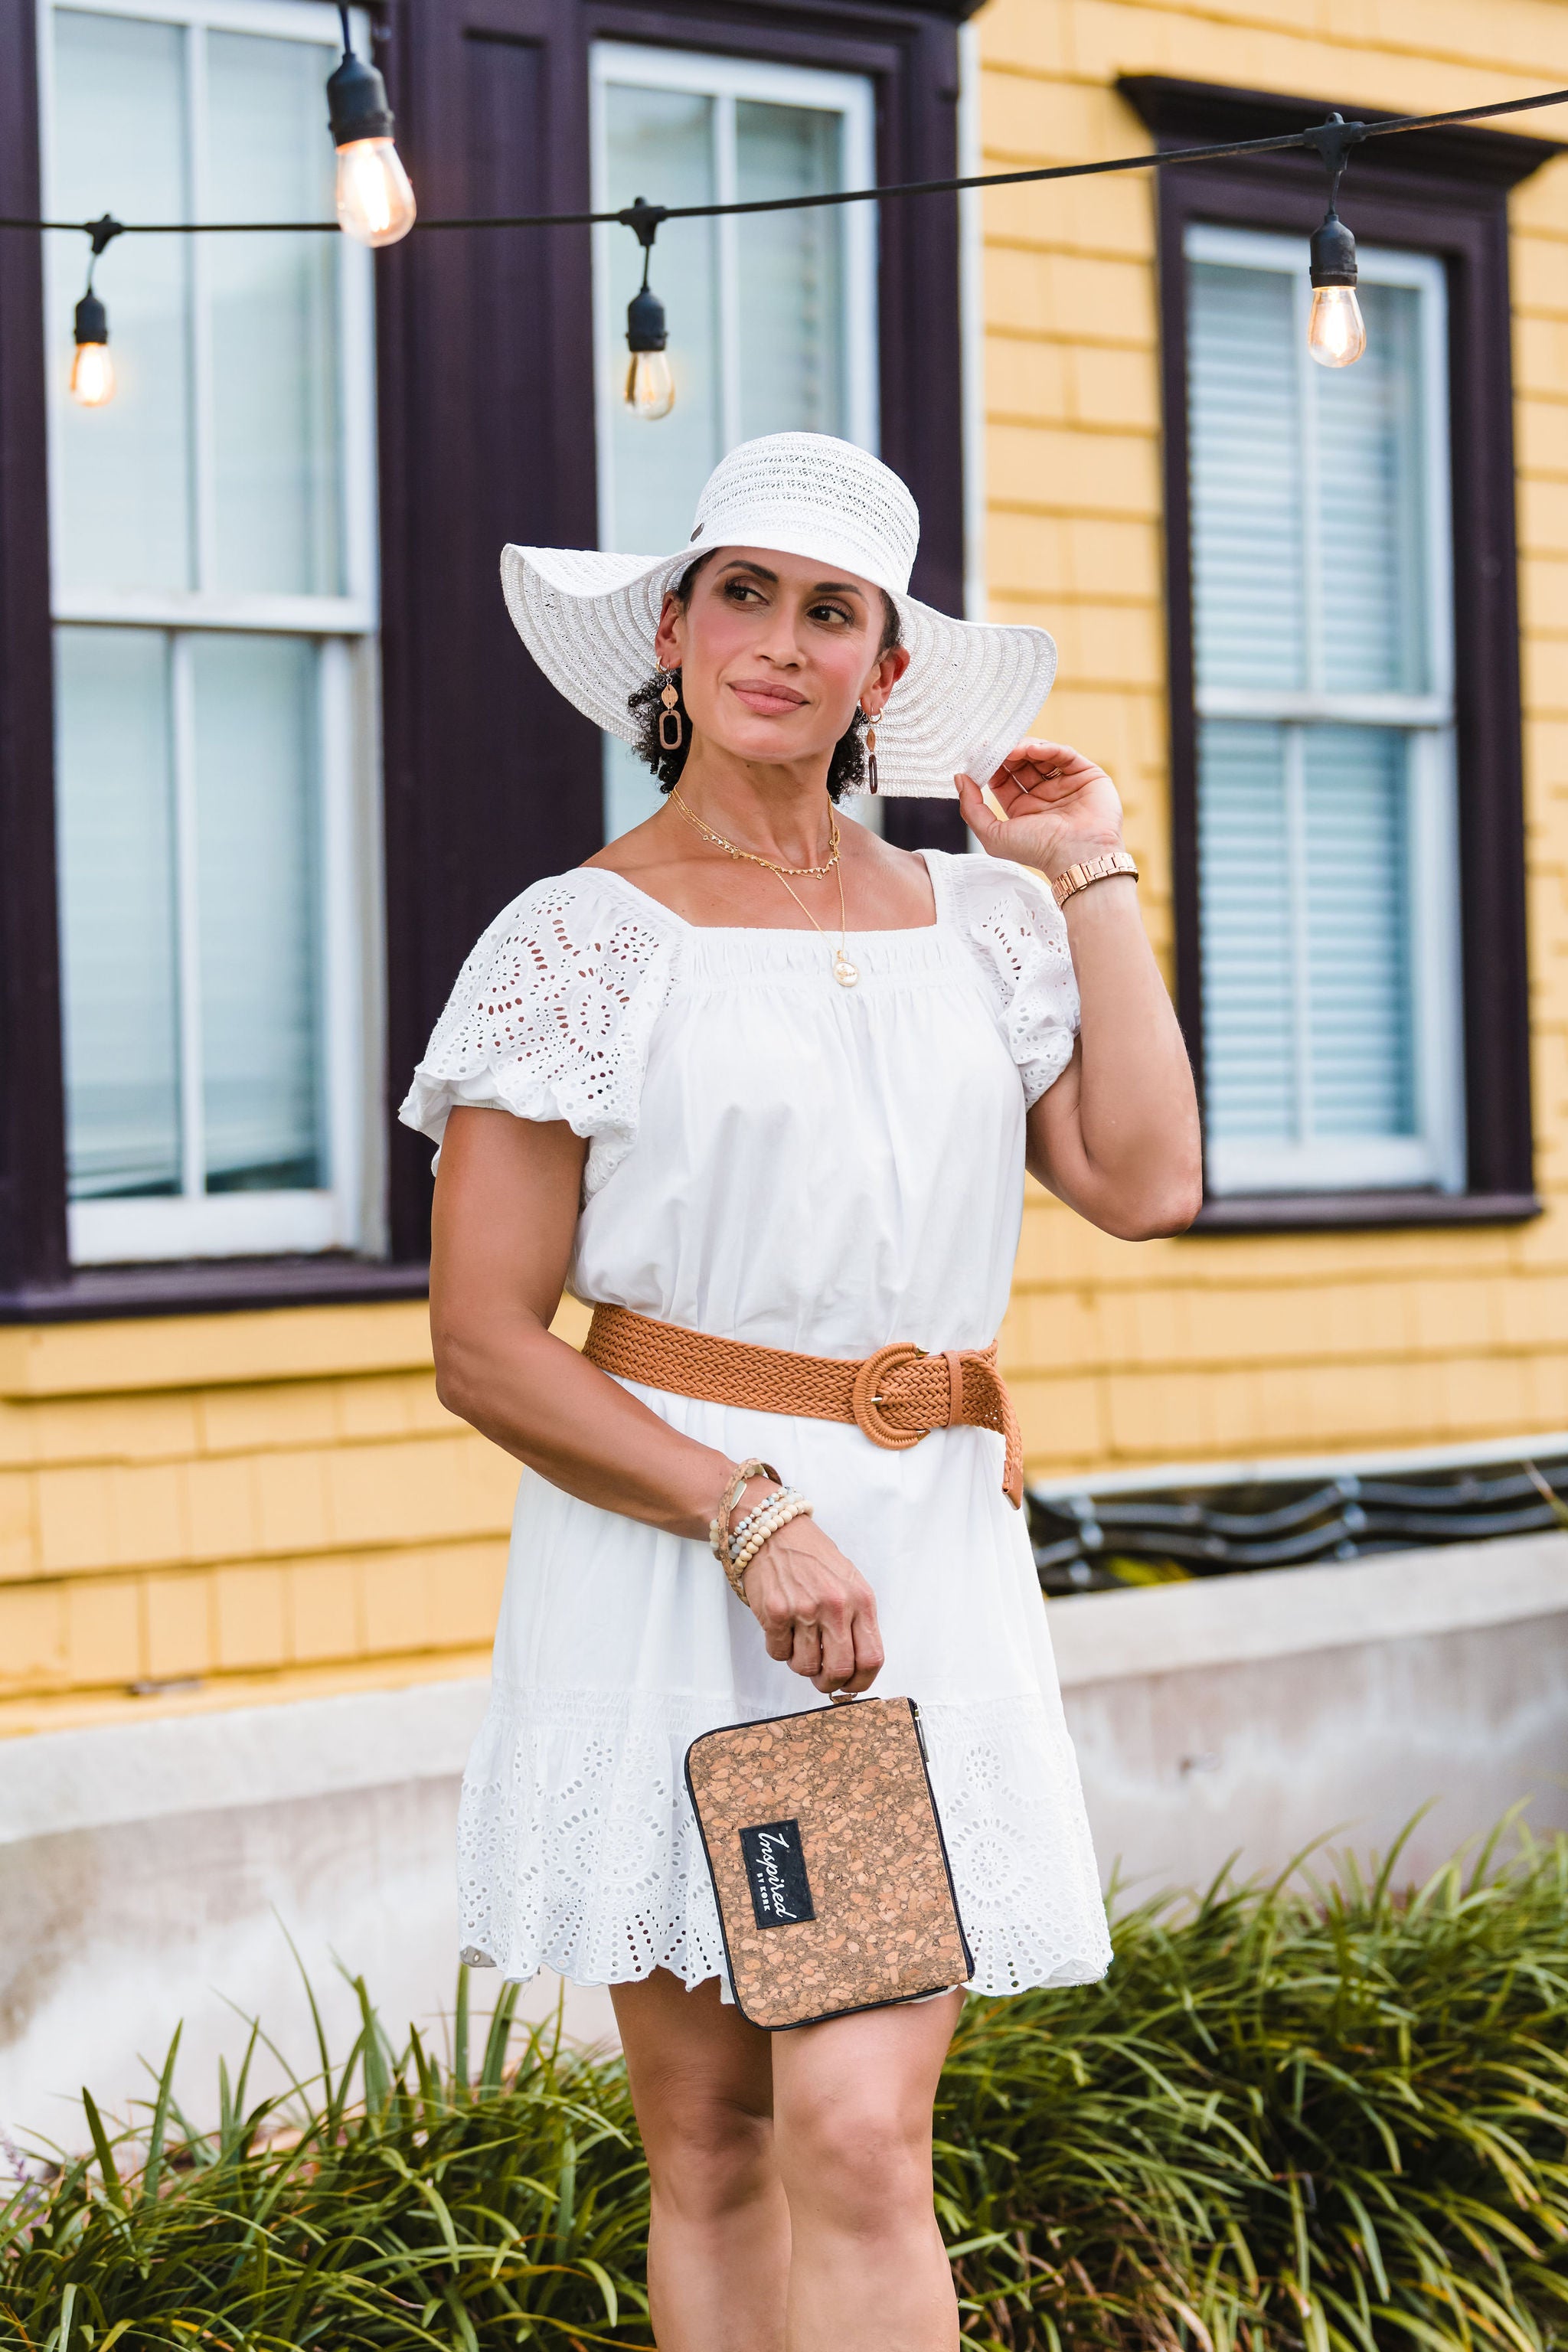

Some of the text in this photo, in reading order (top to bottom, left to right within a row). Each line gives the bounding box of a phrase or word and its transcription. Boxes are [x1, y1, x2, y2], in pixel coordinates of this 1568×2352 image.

[756, 1832, 797, 1919] Inspired
[756, 1873, 771, 1912] BY KORK
